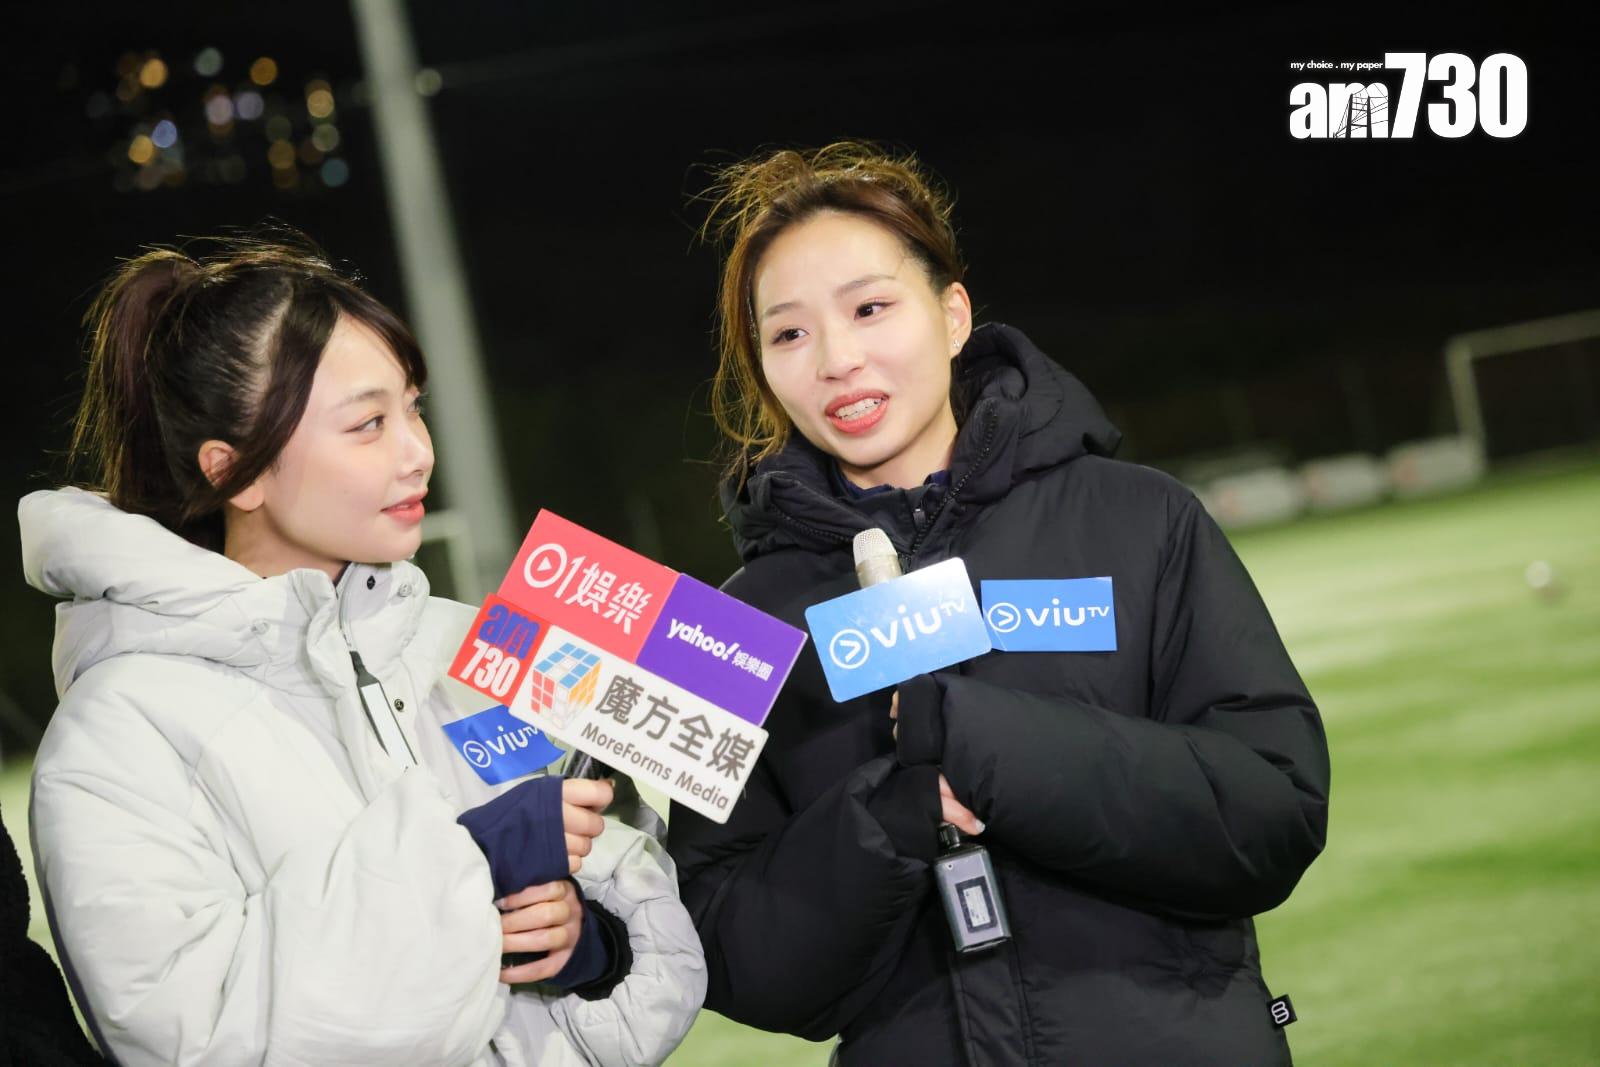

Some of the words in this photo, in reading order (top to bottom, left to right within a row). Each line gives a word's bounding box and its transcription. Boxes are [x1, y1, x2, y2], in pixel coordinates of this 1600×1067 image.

[479, 604, 540, 660] am
[666, 617, 740, 661] yahoo!
[459, 638, 521, 698] 730
[594, 673, 756, 782] 魔方全媒
[580, 721, 672, 781] MoreForms
[675, 769, 730, 811] Media
